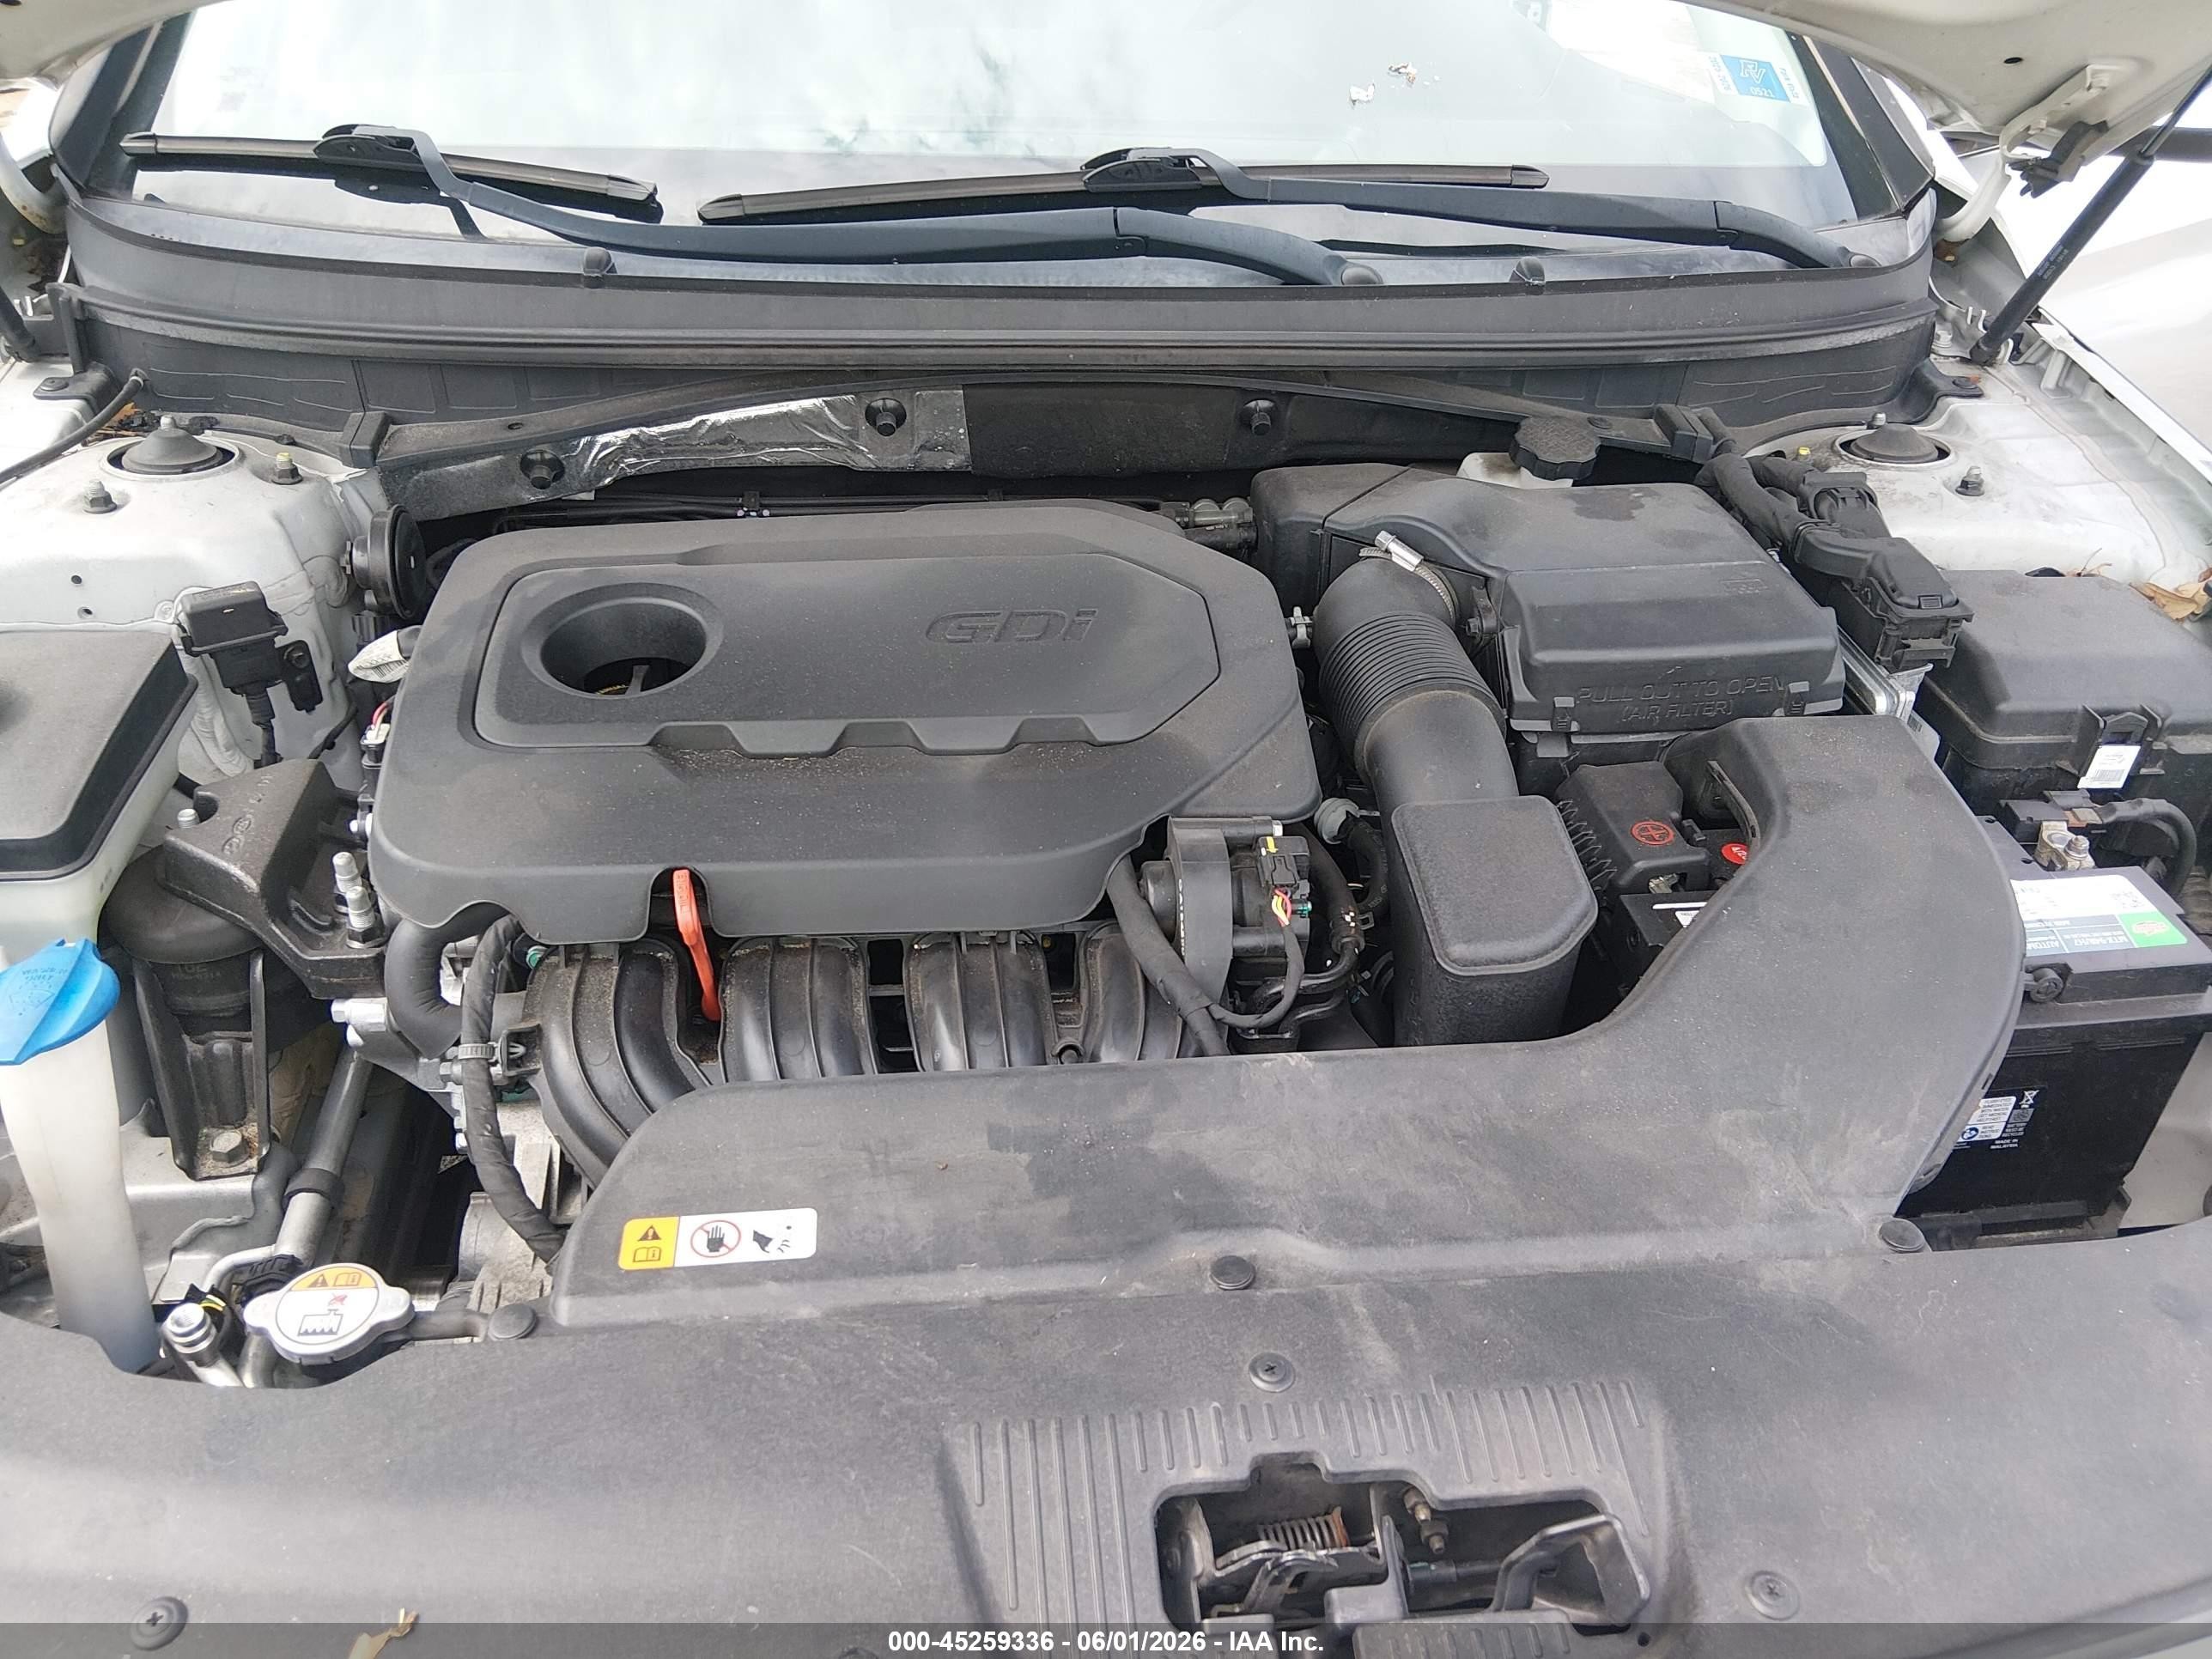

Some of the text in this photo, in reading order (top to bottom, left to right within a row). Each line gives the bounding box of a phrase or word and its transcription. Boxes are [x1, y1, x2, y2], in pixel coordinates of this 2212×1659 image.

[926, 606, 1098, 643] GDi
[1576, 675, 1788, 703] PULL OUT TO OPEN
